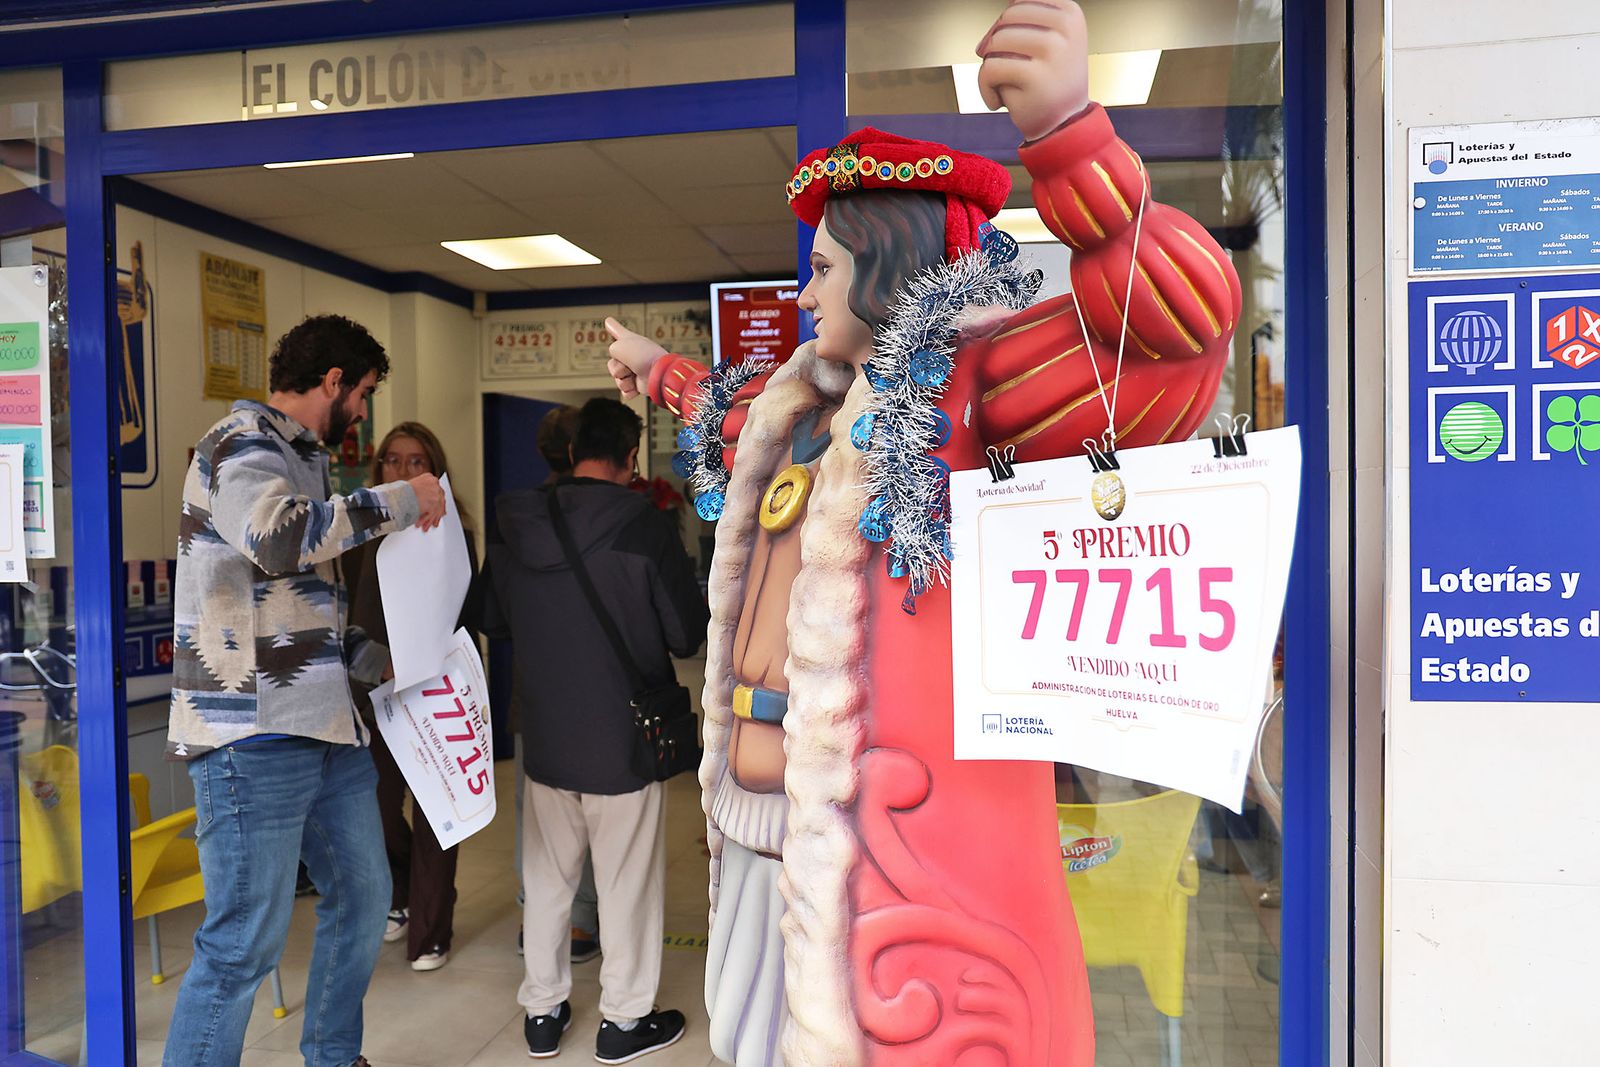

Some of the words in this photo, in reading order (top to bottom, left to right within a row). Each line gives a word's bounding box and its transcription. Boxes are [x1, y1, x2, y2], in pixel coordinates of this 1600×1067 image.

[253, 63, 297, 114] EL
[308, 43, 445, 111] COLÓN
[1508, 142, 1515, 151] y
[1458, 155, 1508, 165] Apuestas
[1512, 153, 1528, 161] del
[1534, 151, 1571, 160] Estado
[1496, 177, 1549, 189] INVIERNO
[1560, 188, 1590, 196] Sábados
[1498, 221, 1544, 233] VERANO
[1475, 236, 1501, 244] Viernes
[1559, 232, 1590, 240] Sábados
[750, 309, 780, 319] GORDO
[495, 332, 553, 347] 43422
[1190, 464, 1202, 474] 22
[1203, 462, 1214, 473] de
[1217, 458, 1270, 473] Diciembre
[1073, 523, 1191, 559] PREMIO
[1420, 565, 1552, 593] Loterías
[1560, 571, 1581, 600] y
[1011, 567, 1236, 652] 77715
[1420, 610, 1570, 644] Apuestas
[1067, 655, 1129, 678] VENDIDO
[1420, 655, 1531, 683] Estado
[1097, 688, 1107, 697] DE
[1148, 694, 1158, 703] EL
[1191, 700, 1201, 709] DE
[1202, 701, 1219, 712] ORO
[1106, 708, 1138, 720] HUELVA
[421, 674, 490, 795] 77715
[422, 716, 445, 756] VENDIDO
[1006, 726, 1053, 735] NACIONAL
[1062, 840, 1107, 857] Lipton
[1069, 860, 1088, 872] Ice
